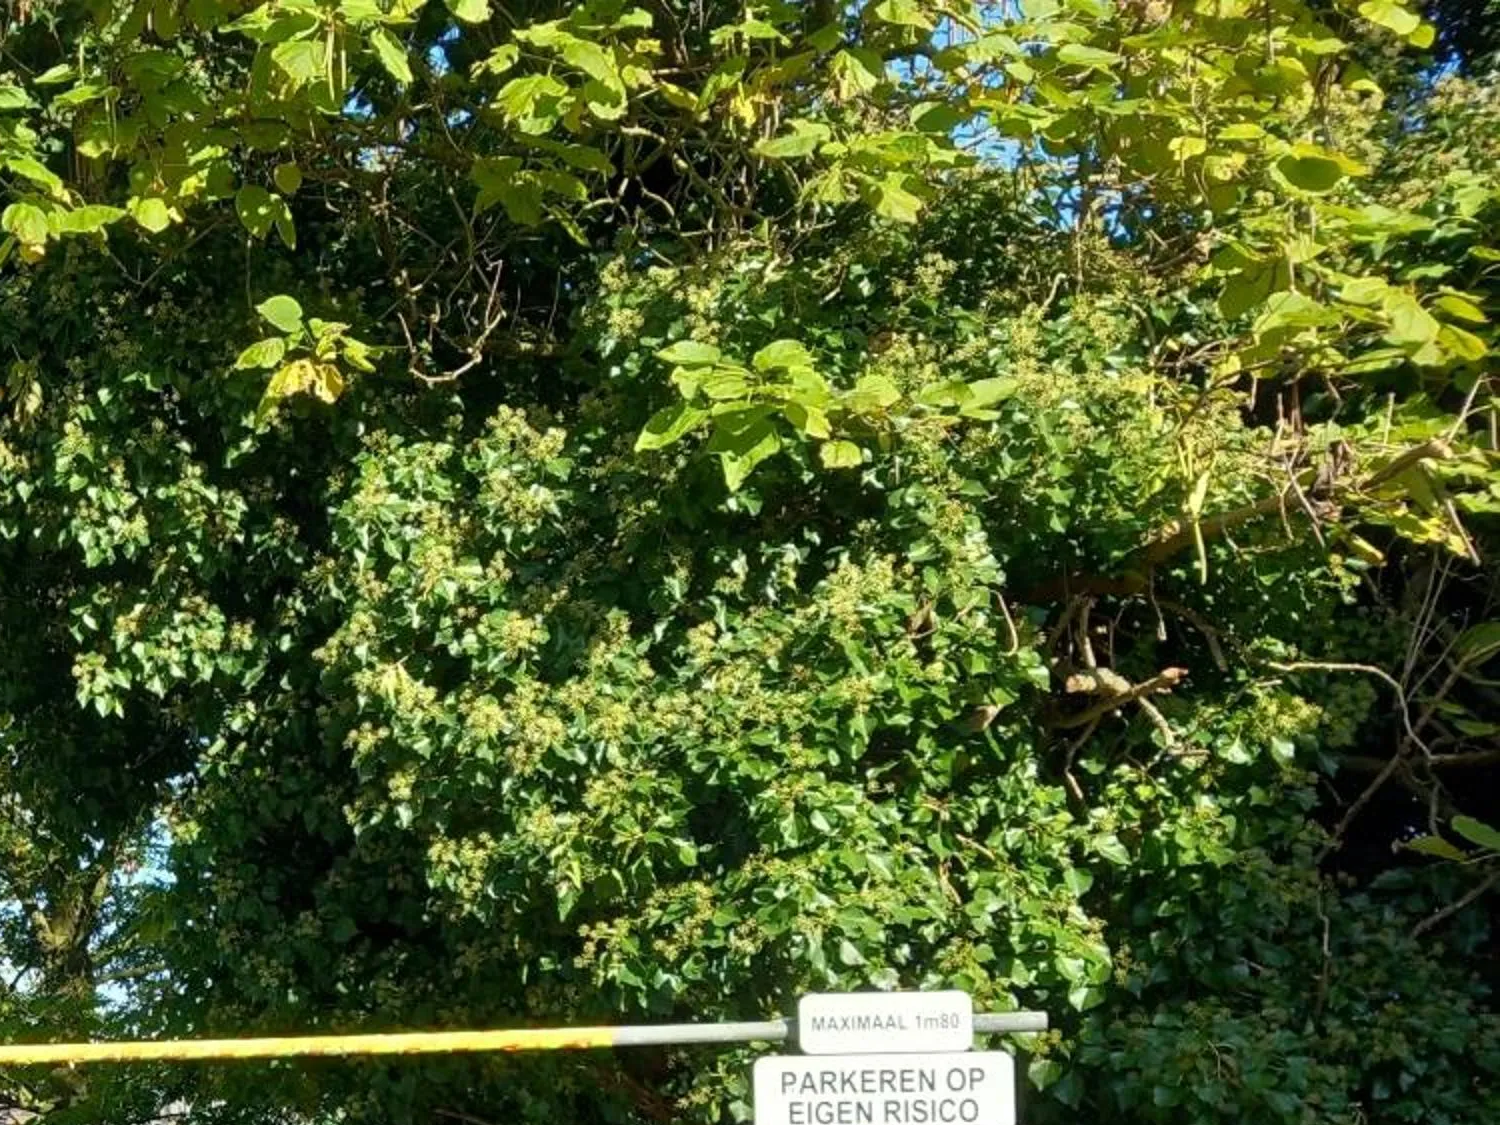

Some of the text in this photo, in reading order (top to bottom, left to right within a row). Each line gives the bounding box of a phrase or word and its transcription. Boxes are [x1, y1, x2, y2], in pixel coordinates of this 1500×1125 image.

[811, 1012, 961, 1032] MAXIMAAL 1m80
[781, 1067, 986, 1095] PARKEREN OP
[789, 1098, 980, 1125] EIGEN RISICO
